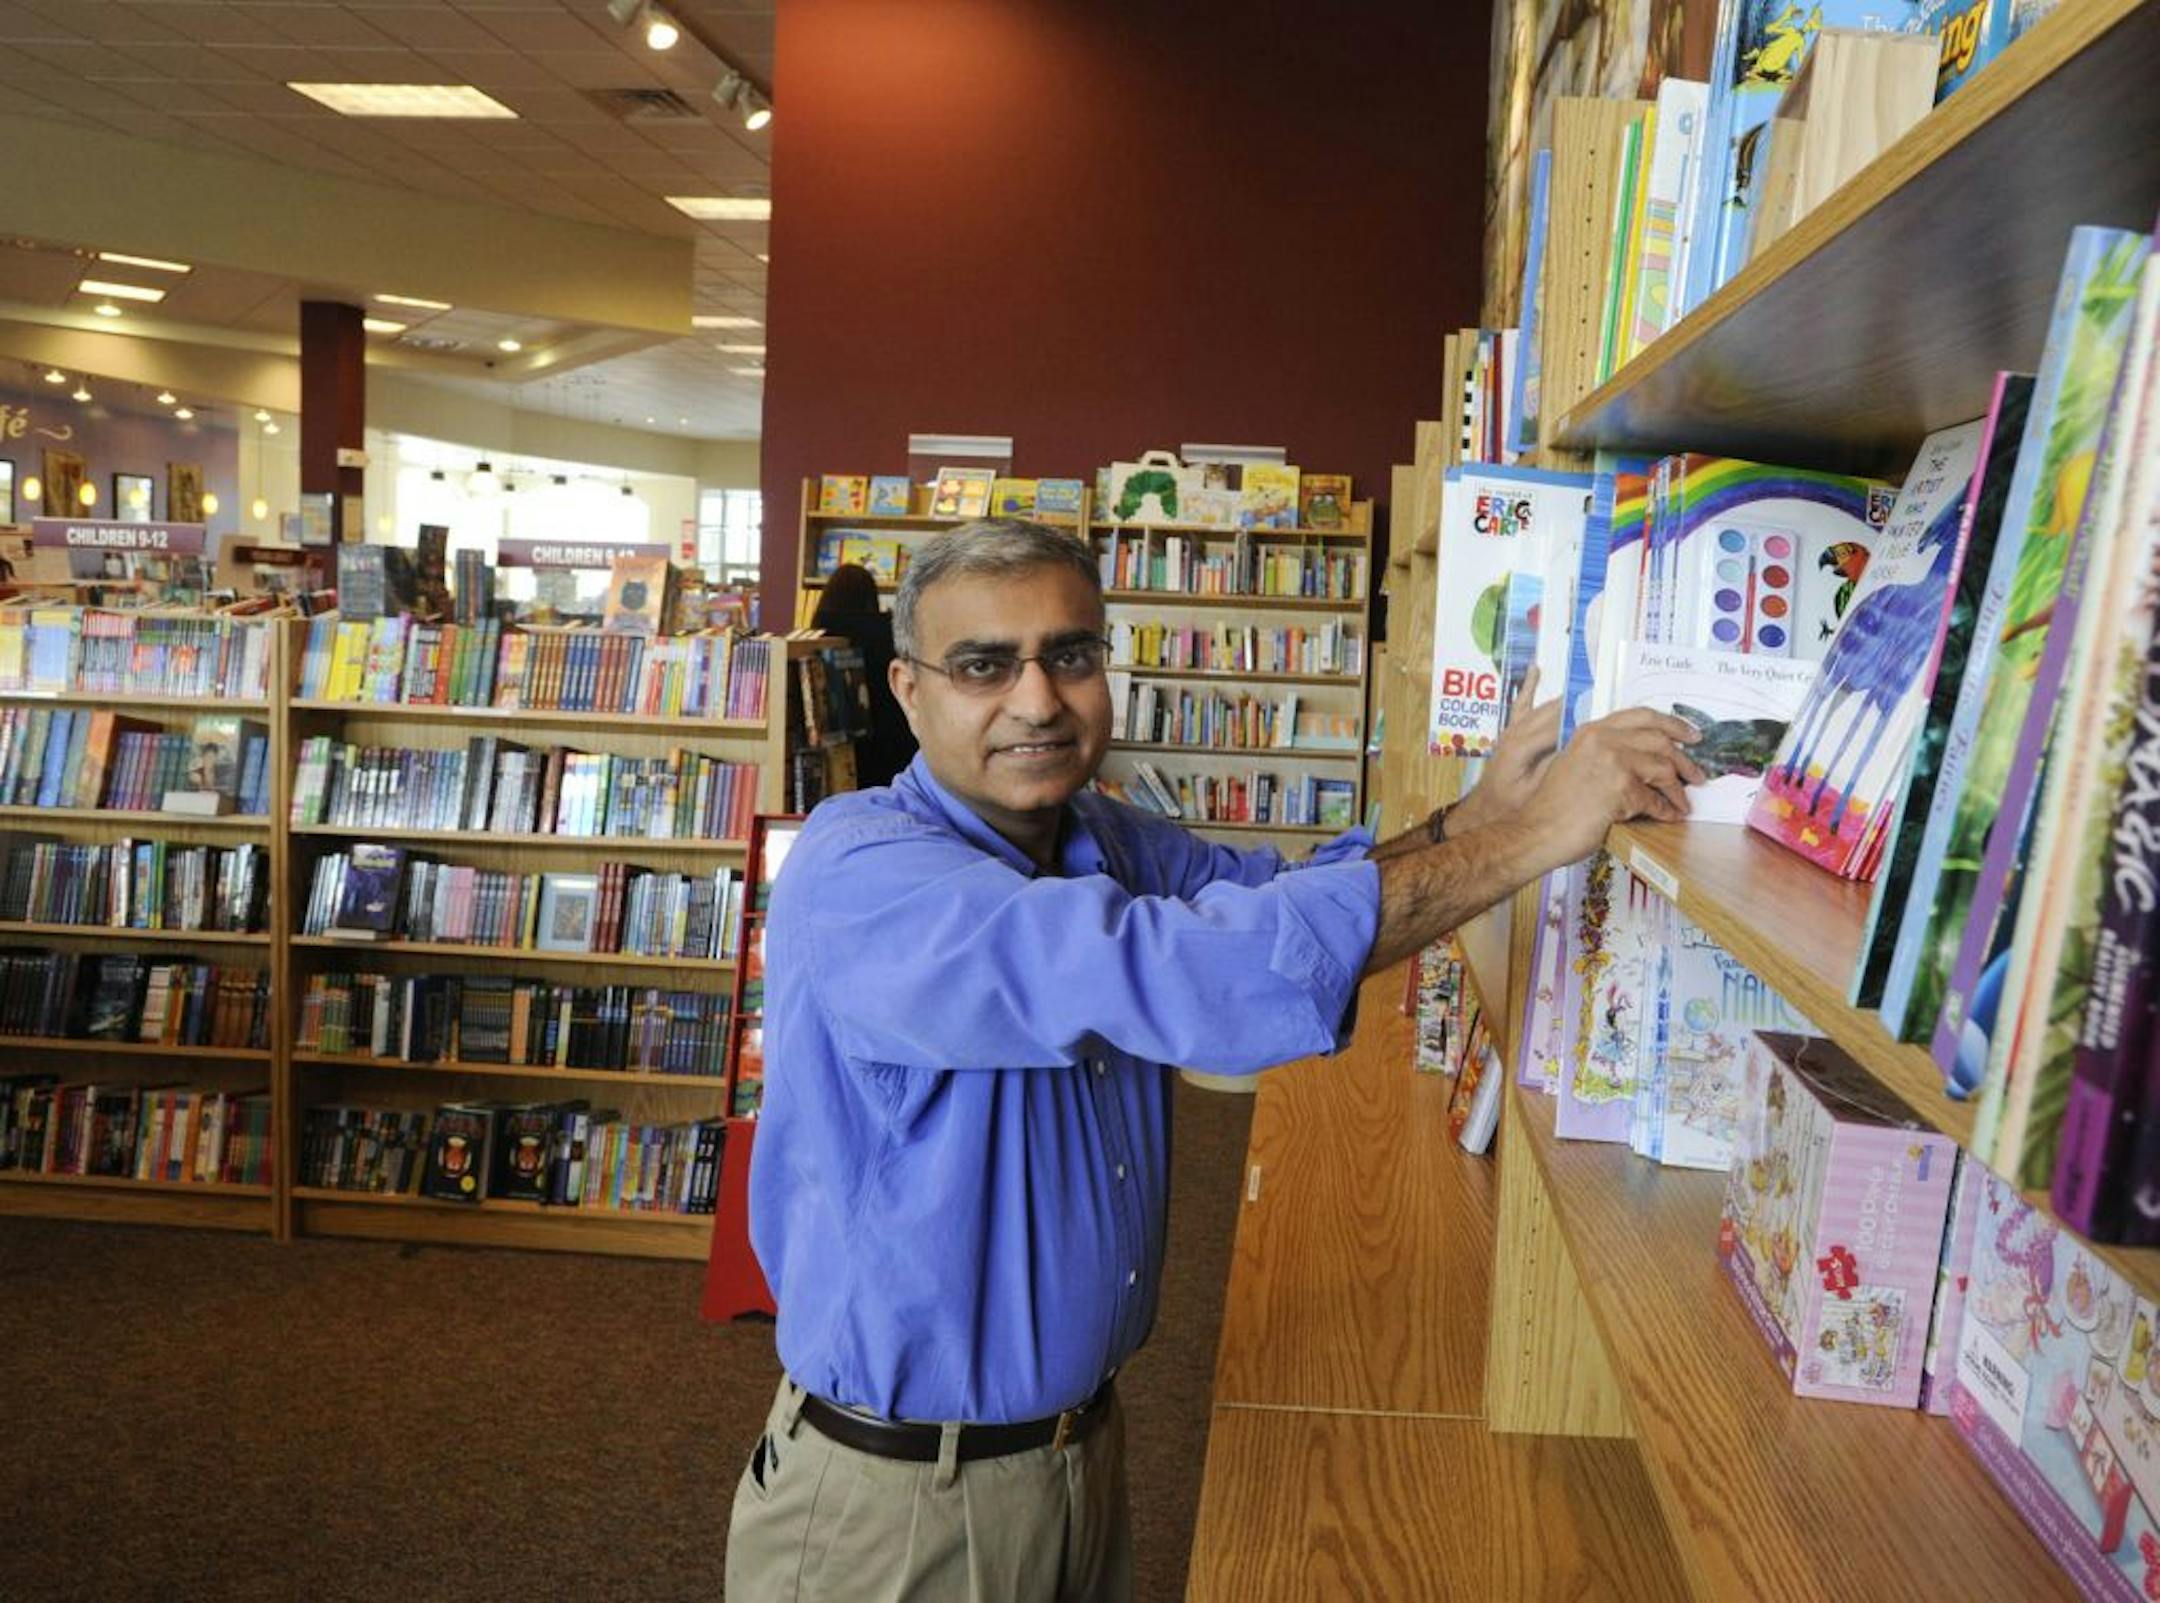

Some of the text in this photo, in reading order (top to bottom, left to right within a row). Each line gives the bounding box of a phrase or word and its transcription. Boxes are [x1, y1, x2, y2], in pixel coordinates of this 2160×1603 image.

[66, 527, 168, 548] CHILDREN 9-12
[531, 545, 604, 565] CHILDREN
[1442, 668, 1497, 700] BIG
[1438, 712, 1480, 729] BOOK
